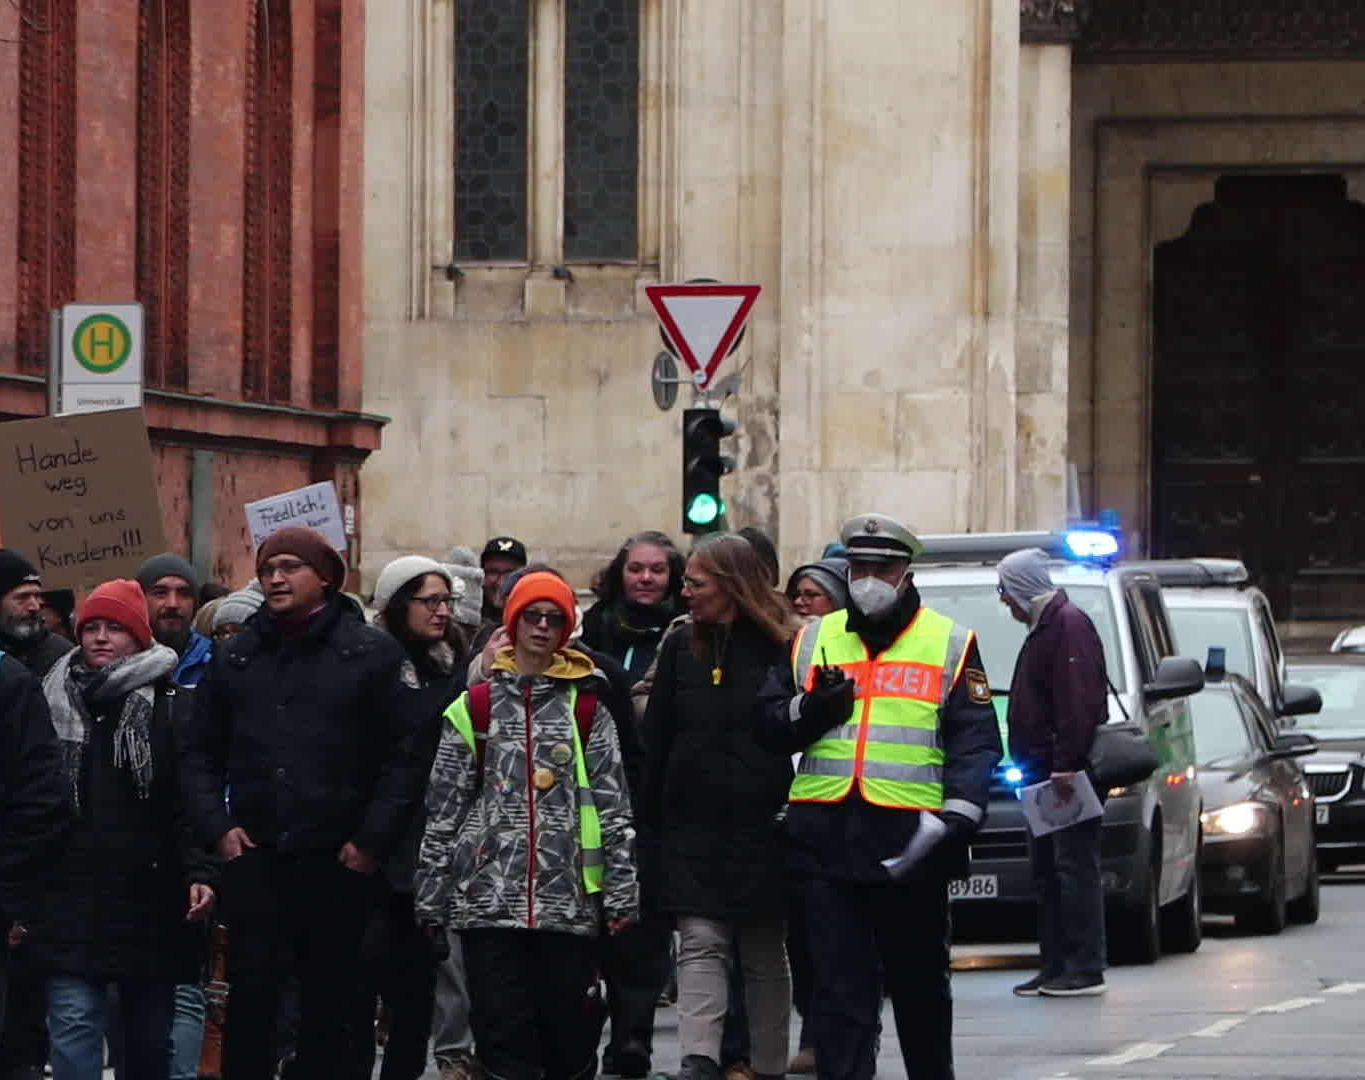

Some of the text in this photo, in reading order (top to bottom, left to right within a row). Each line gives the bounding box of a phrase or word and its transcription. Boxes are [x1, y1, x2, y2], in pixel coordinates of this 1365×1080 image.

[90, 327, 115, 361] H
[45, 476, 87, 497] weg
[28, 509, 126, 533] von uns
[37, 528, 144, 569] Kindern!!!
